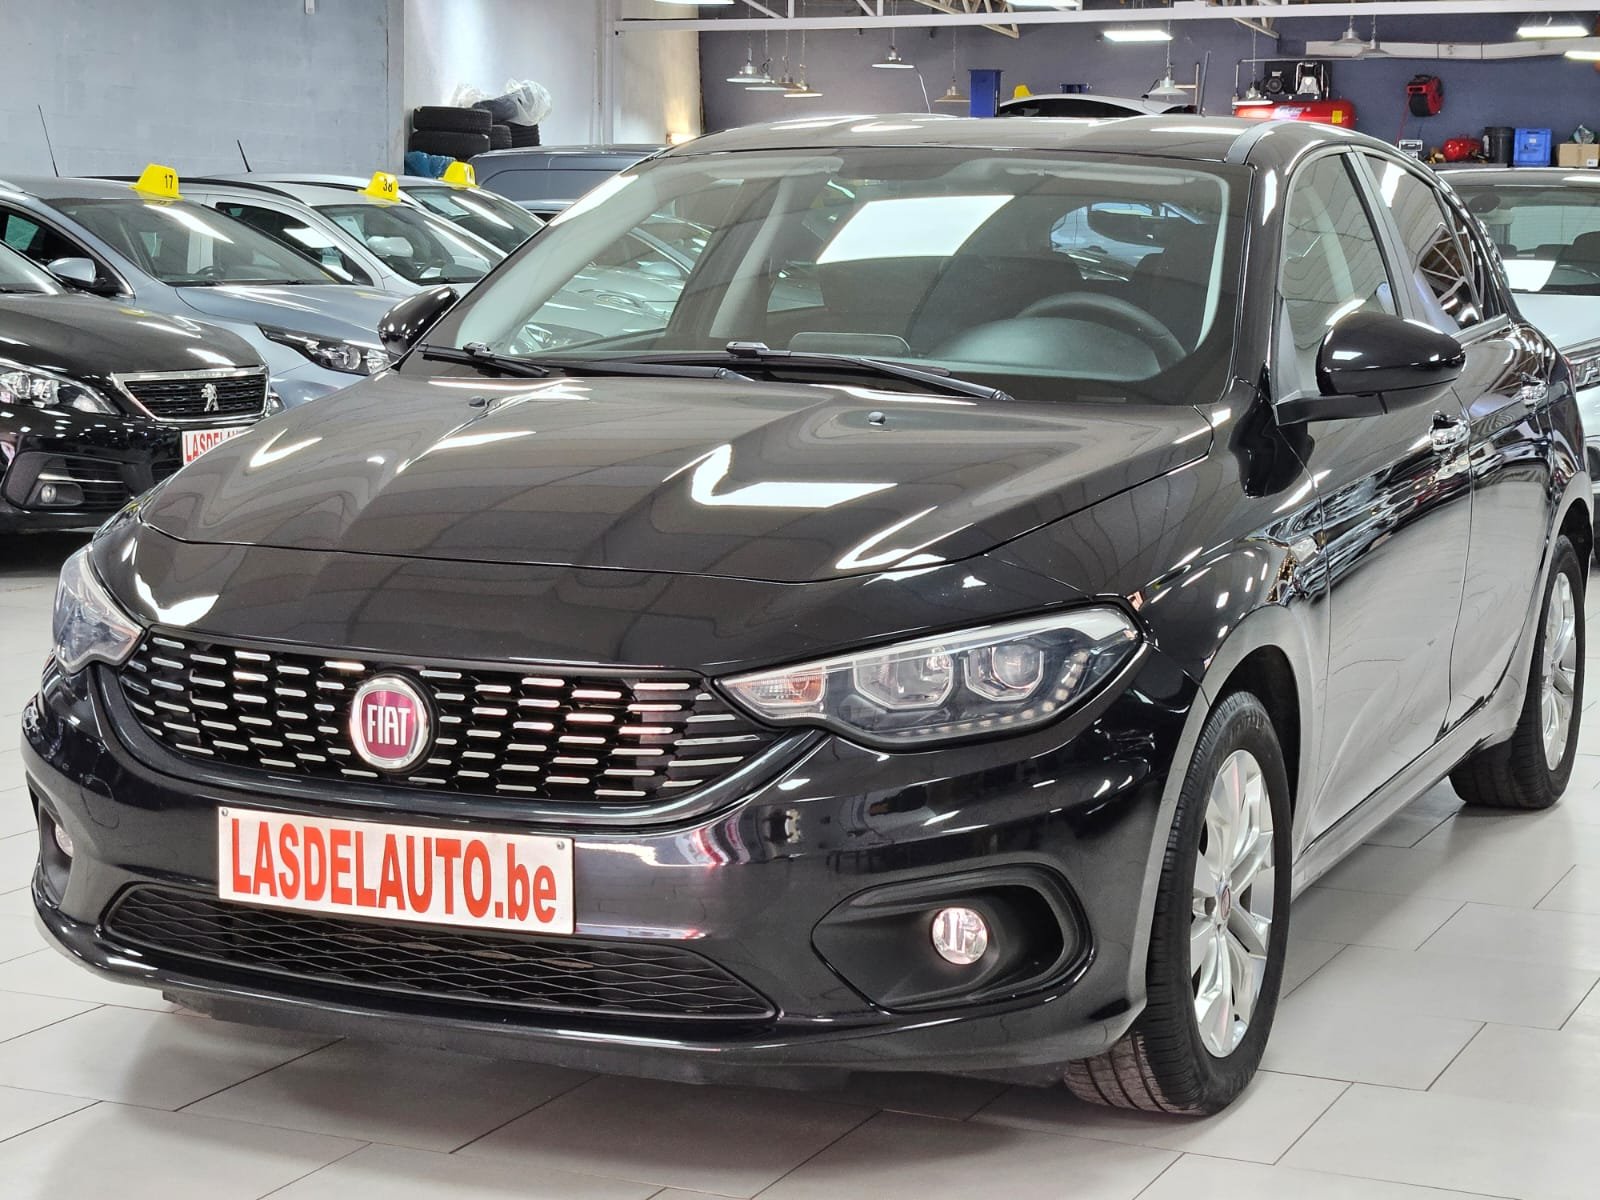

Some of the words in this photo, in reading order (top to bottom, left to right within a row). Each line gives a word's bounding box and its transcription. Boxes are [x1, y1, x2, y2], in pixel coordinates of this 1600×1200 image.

[164, 173, 174, 190] 17
[382, 178, 393, 193] 38
[367, 704, 411, 746] FIAT
[231, 818, 557, 924] LASDELAUTO.be
